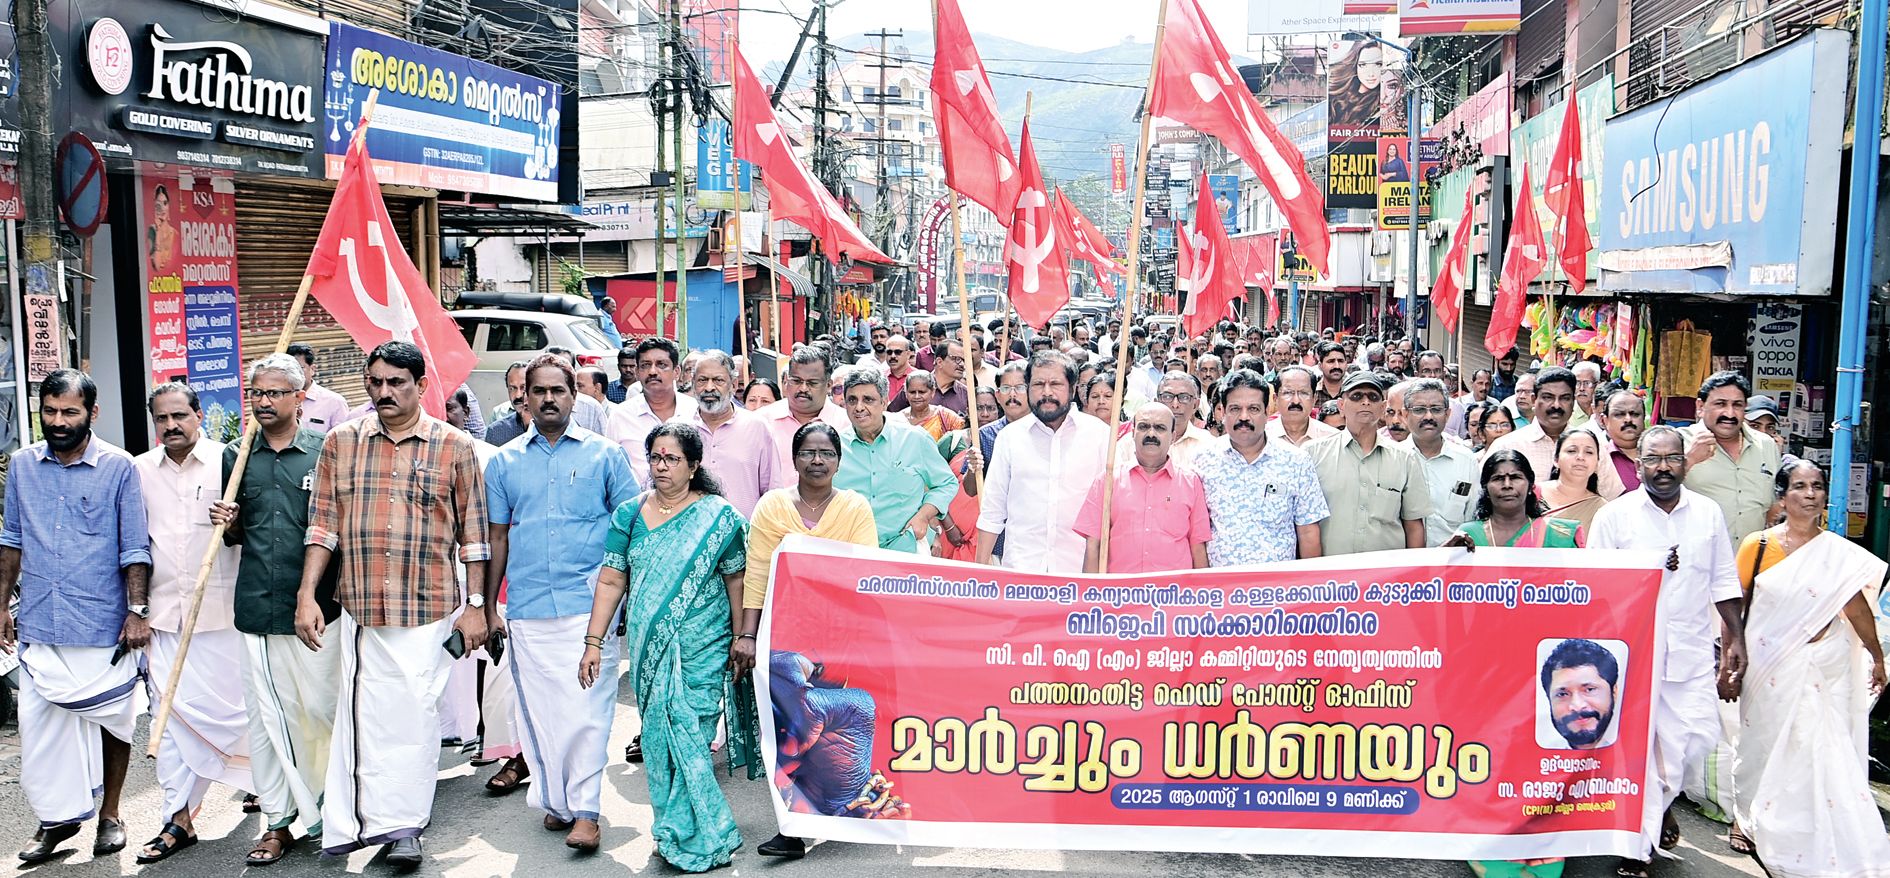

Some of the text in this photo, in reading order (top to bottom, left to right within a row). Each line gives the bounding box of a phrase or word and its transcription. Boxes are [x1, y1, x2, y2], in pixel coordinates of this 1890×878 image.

[1281, 17, 1301, 26] Ather
[1303, 17, 1326, 26] Space
[1328, 15, 1370, 24] Experience
[148, 22, 316, 123] Fathima
[351, 47, 547, 126] അശോകാ മെറ്റൽസ്
[129, 110, 212, 134] GOLD COVERING
[1330, 129, 1352, 137] FAIR
[226, 124, 315, 149] SILVER ORNAMENTS
[1158, 130, 1178, 140] JOHN'S
[1391, 187, 1431, 196] MATA
[1619, 120, 1771, 239] SAMSUNG
[193, 191, 215, 208] KSA
[603, 203, 629, 216] Prnt
[1760, 336, 1795, 348] vivo
[1757, 350, 1796, 364] oppo
[1757, 366, 1794, 376] NOKIA
[1004, 582, 1077, 603] മലയാളി
[1083, 582, 1225, 609] കന്യാസ്ത്രീകളെ
[1230, 580, 1359, 608] കള്ളക്കേസിൽ
[1364, 578, 1443, 606] കുടുക്കി
[1448, 579, 1521, 609] അറസ്റ്റ്
[1522, 580, 1591, 606] ചെയ്ത
[1066, 607, 1379, 640] ബിജെപി സർക്കാറിനെതിരെ
[986, 643, 1442, 672] സി. പി. ഐ (എം) ജില്ലാ കമ്മിറ്റിയുടെ നേതൃത്വത്തിൽ
[1009, 677, 1417, 712] പത്തനംതിട്ട ഹെഡ് പോസ്റ്റ് ഓഫീസ്
[889, 706, 1492, 799] മാർച്ചും ധർണയും
[1120, 787, 1407, 809] 2025 ആഗസ്റ്റ് 1 രാവിലെ 9 മണിക്ക്
[1498, 777, 1639, 801] സ. രാജു എബ്രഹാം
